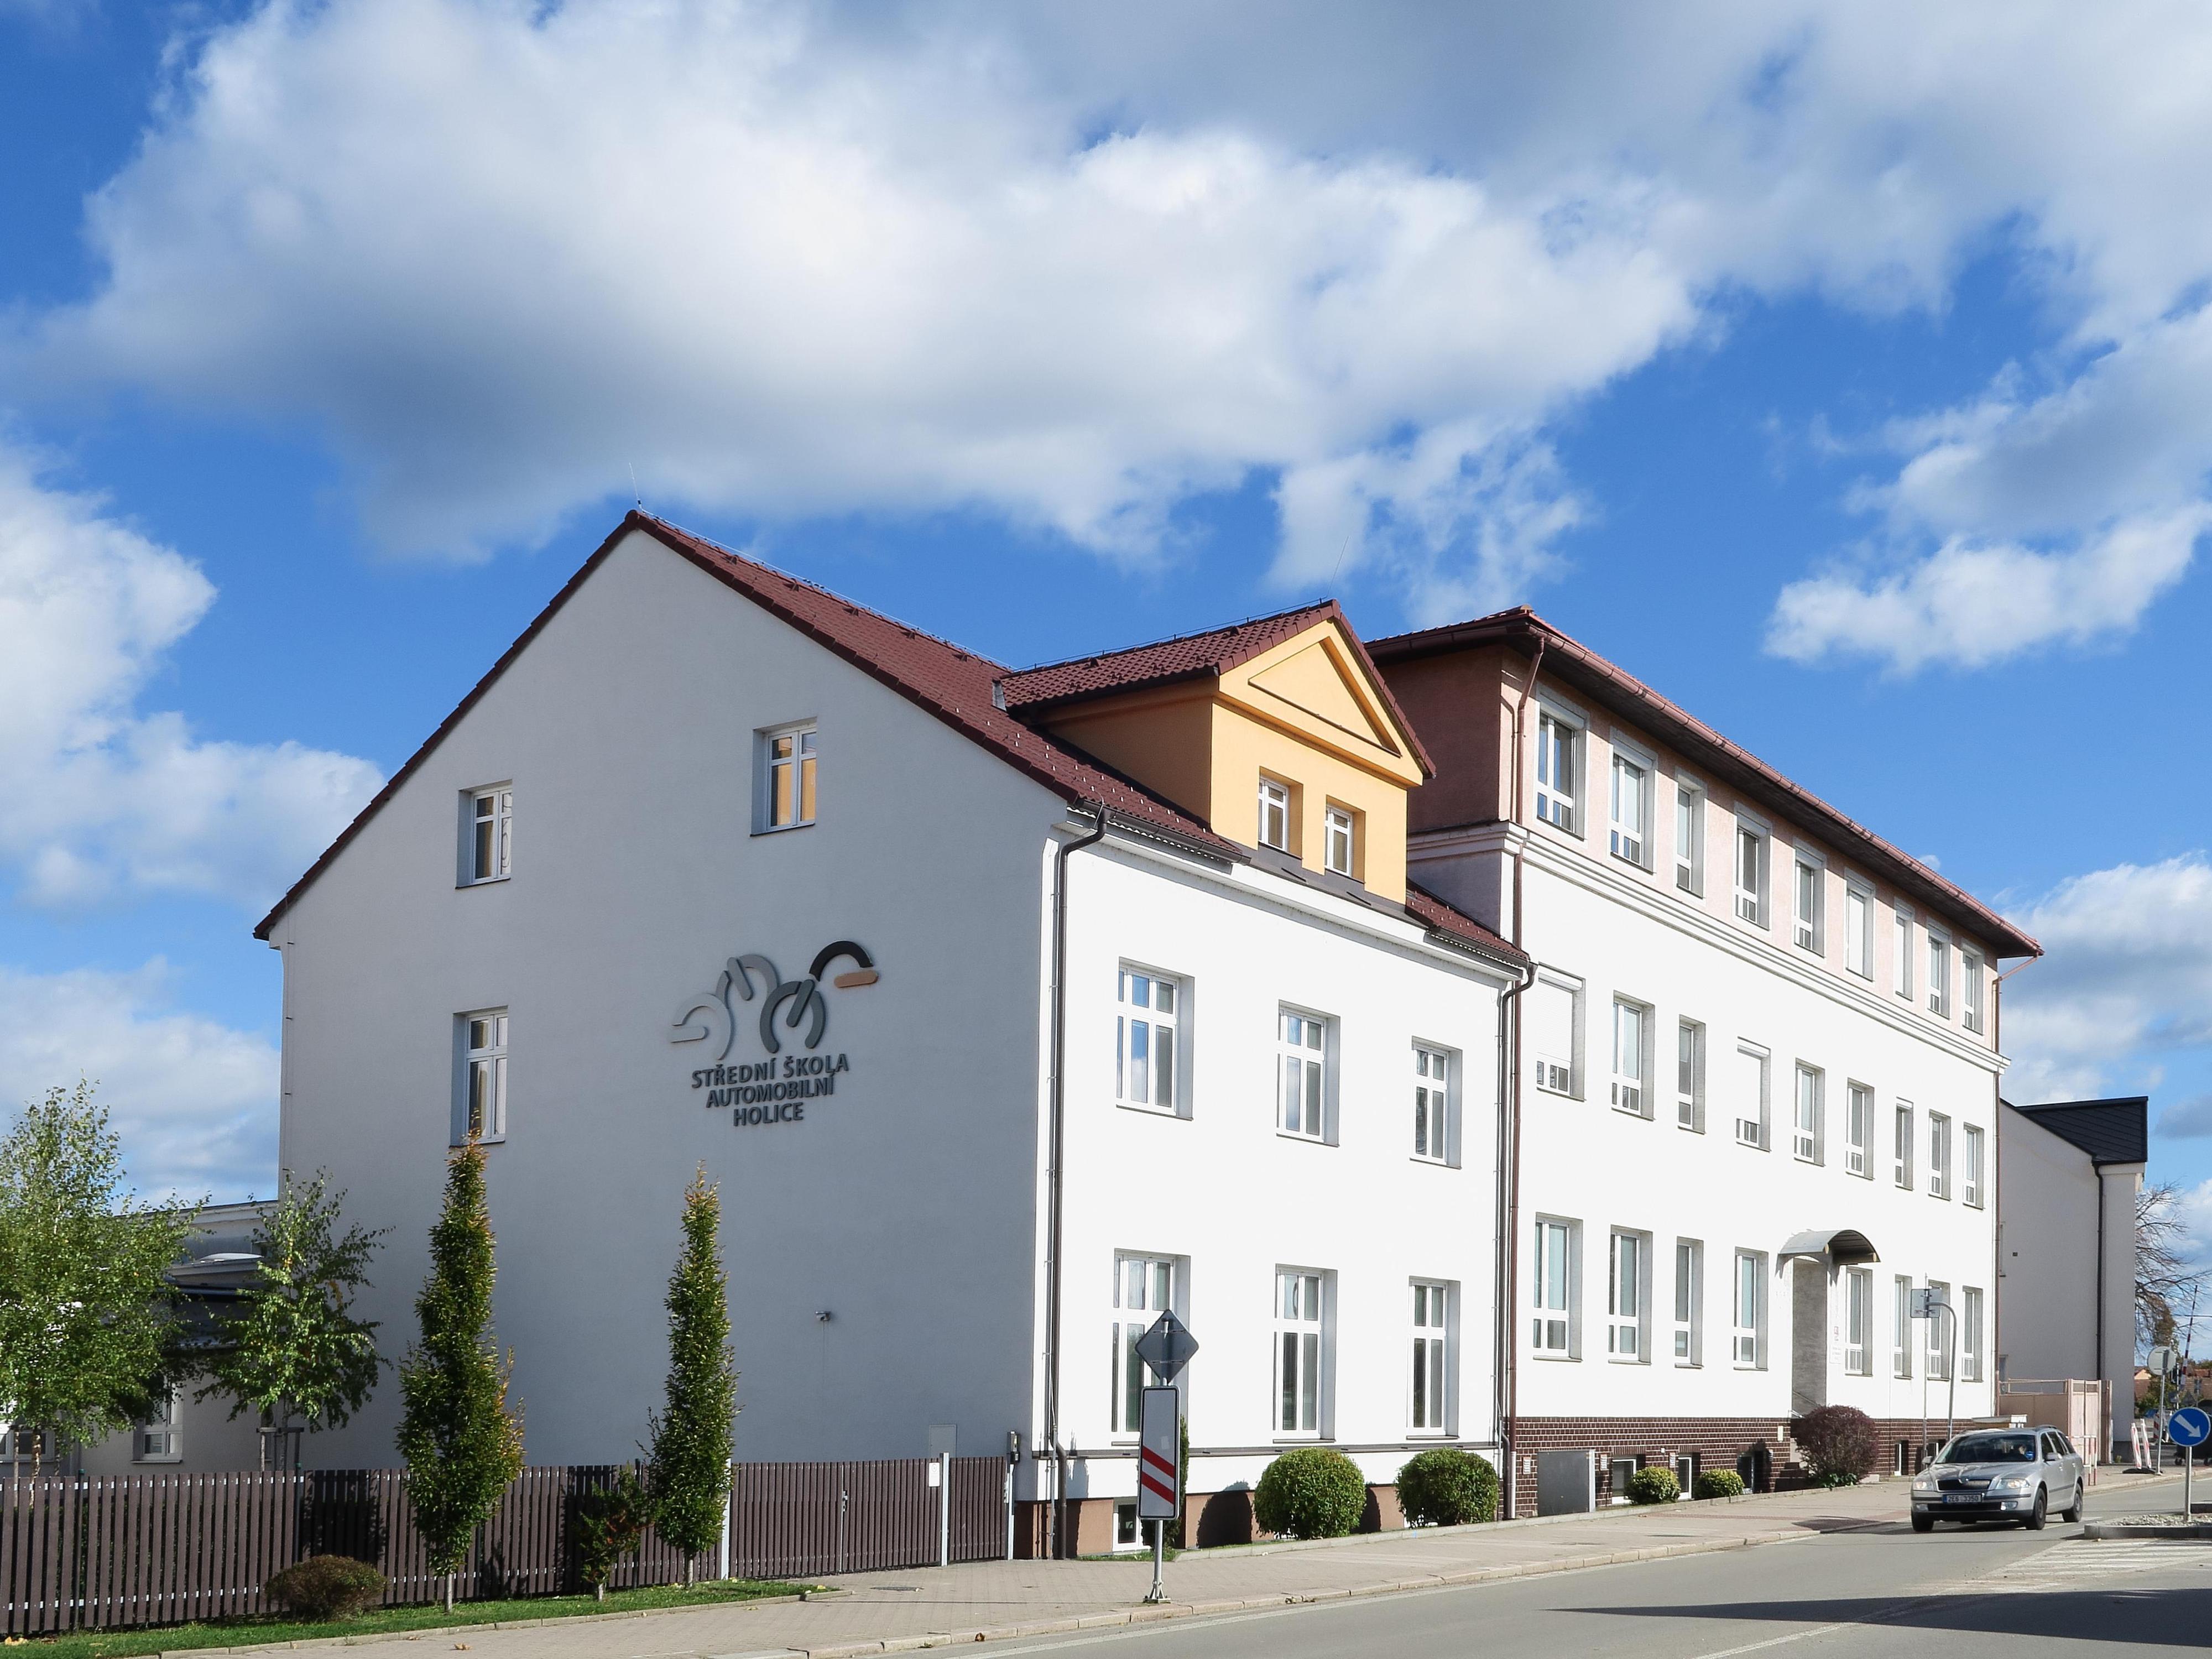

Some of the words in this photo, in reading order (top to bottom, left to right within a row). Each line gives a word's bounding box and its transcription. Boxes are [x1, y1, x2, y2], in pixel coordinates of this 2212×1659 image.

[692, 1057, 776, 1088] STŘEDNÍ
[784, 1053, 849, 1078] ŠKOLA
[706, 1073, 835, 1108] AUTOMOBILNÍ
[734, 1102, 804, 1126] HOLICE
